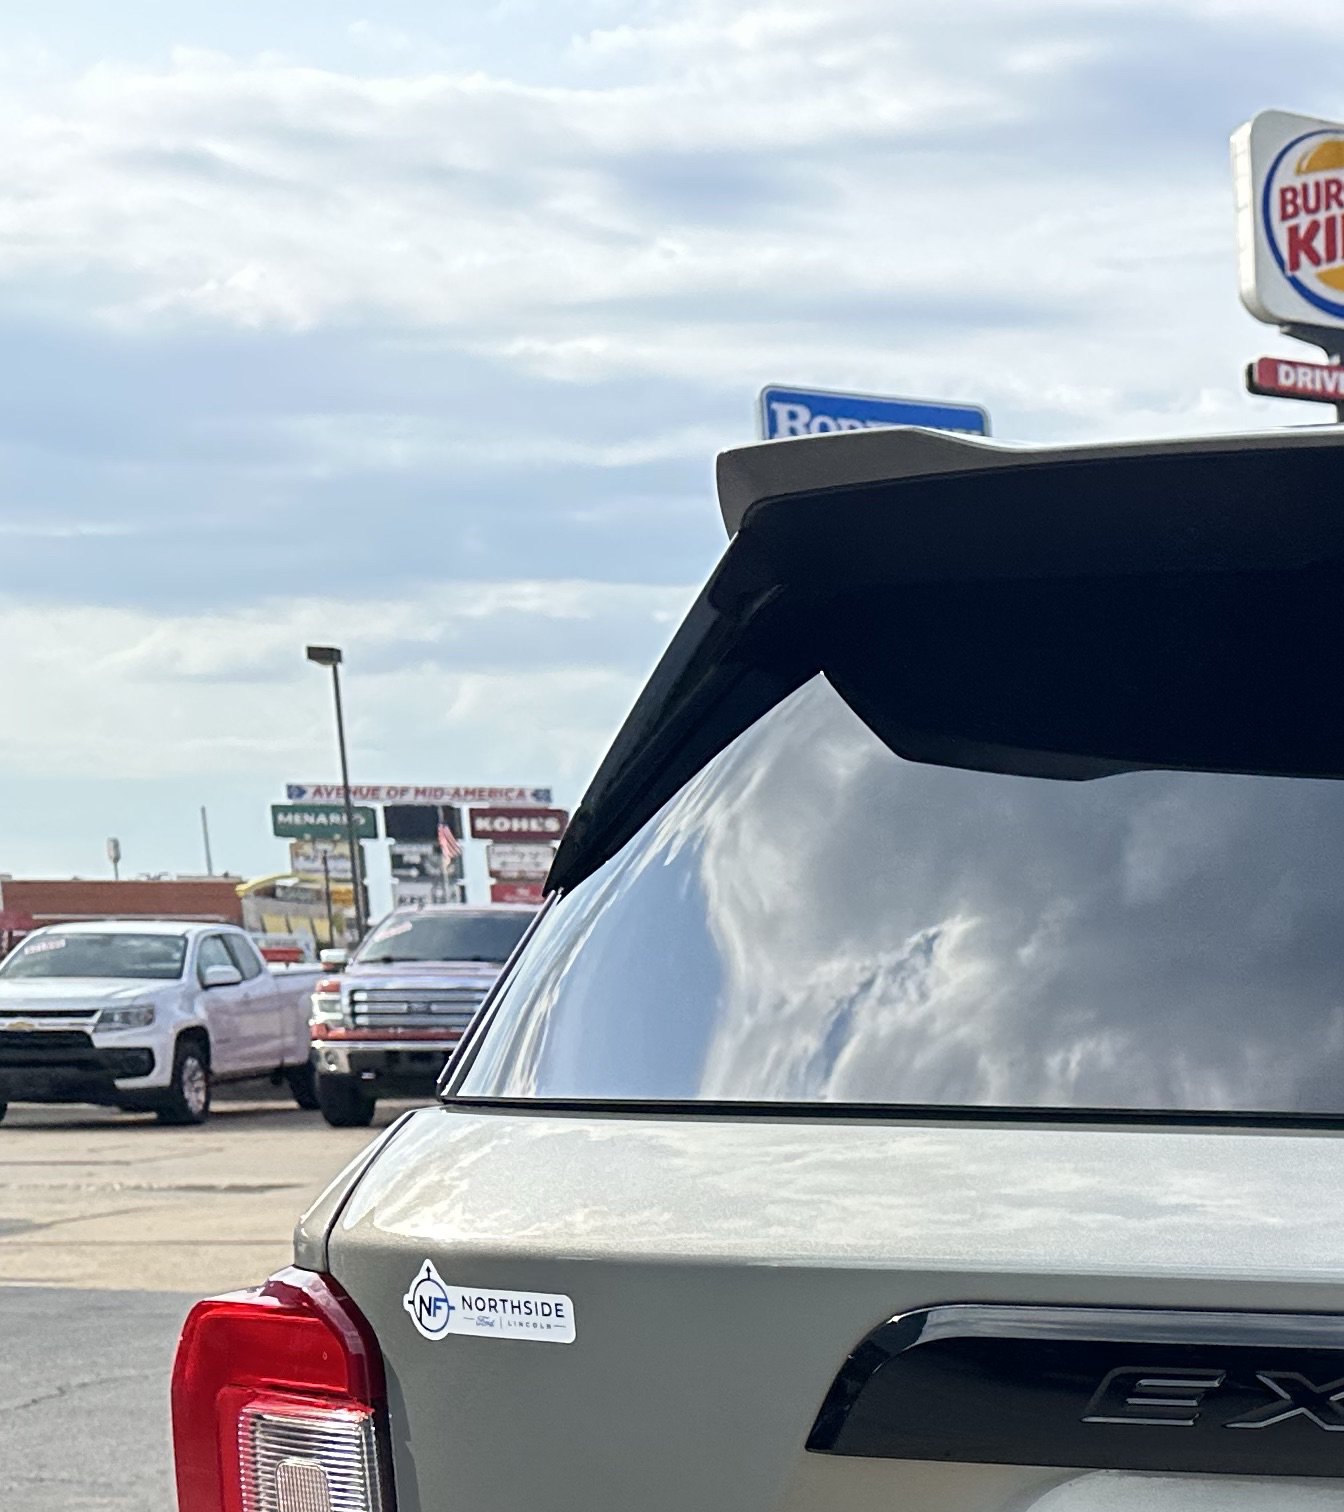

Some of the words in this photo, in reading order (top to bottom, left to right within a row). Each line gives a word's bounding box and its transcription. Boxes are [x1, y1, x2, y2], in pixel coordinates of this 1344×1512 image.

[386, 786, 407, 800] OF
[414, 786, 526, 800] MID-AMERICA
[474, 815, 561, 832] KOHL'S
[419, 1294, 448, 1322] NF
[461, 1295, 565, 1318] NORTHSIDE
